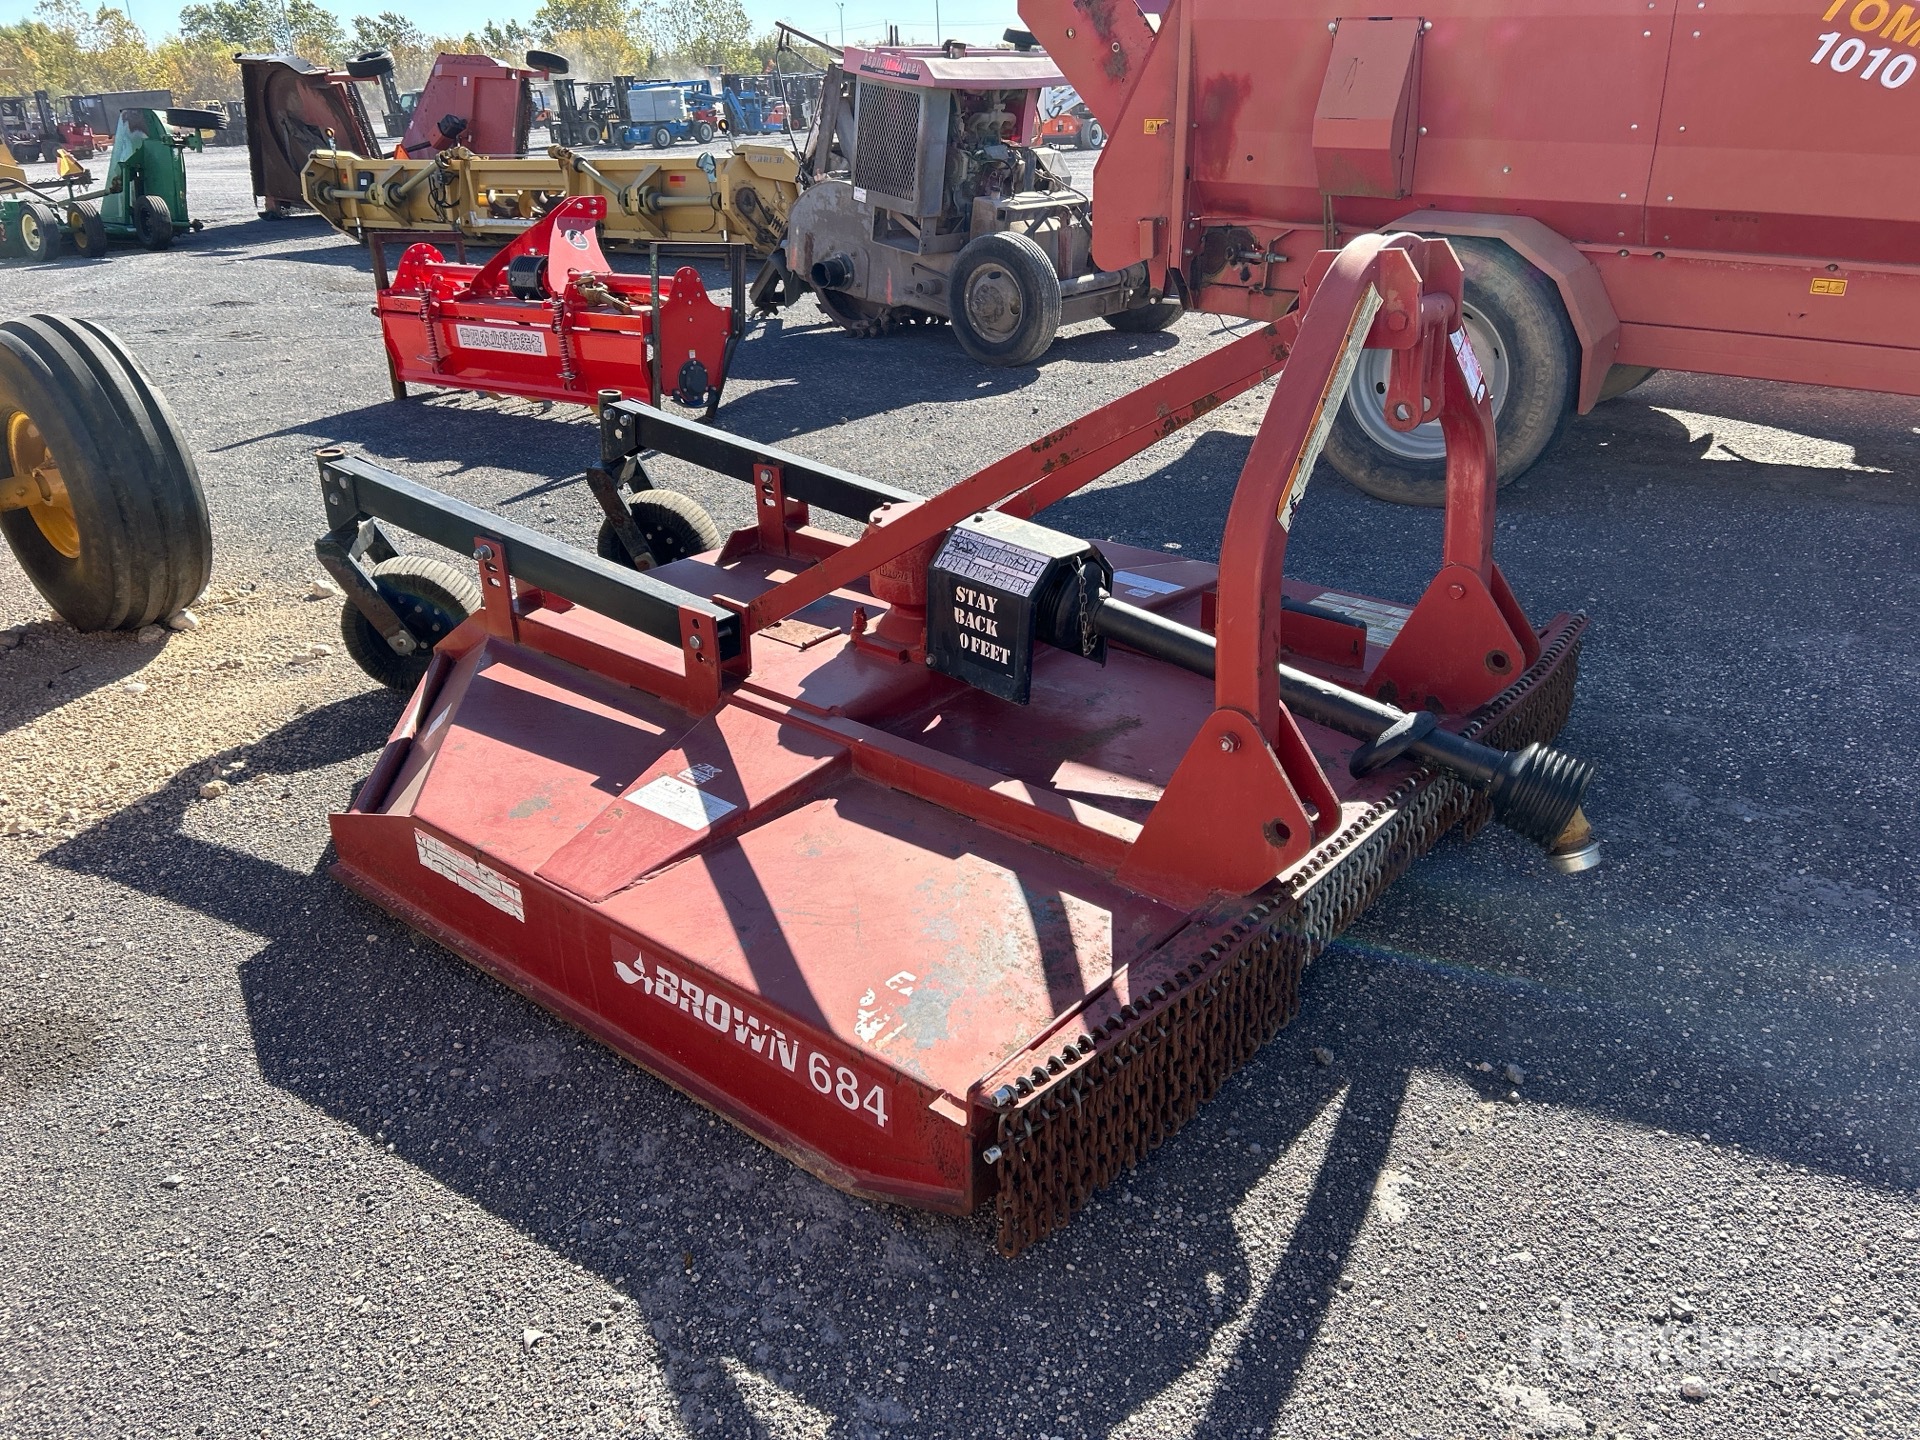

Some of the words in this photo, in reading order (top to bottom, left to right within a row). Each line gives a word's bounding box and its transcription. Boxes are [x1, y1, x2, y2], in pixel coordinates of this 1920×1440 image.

[862, 52, 893, 70] Asphalt
[894, 58, 922, 75] Zipper
[1810, 31, 1917, 90] 1010
[955, 585, 999, 614] STAY
[953, 606, 998, 638] BACK
[970, 636, 1011, 665] FEET
[654, 964, 800, 1073] BROWN
[808, 1050, 889, 1128] 684
